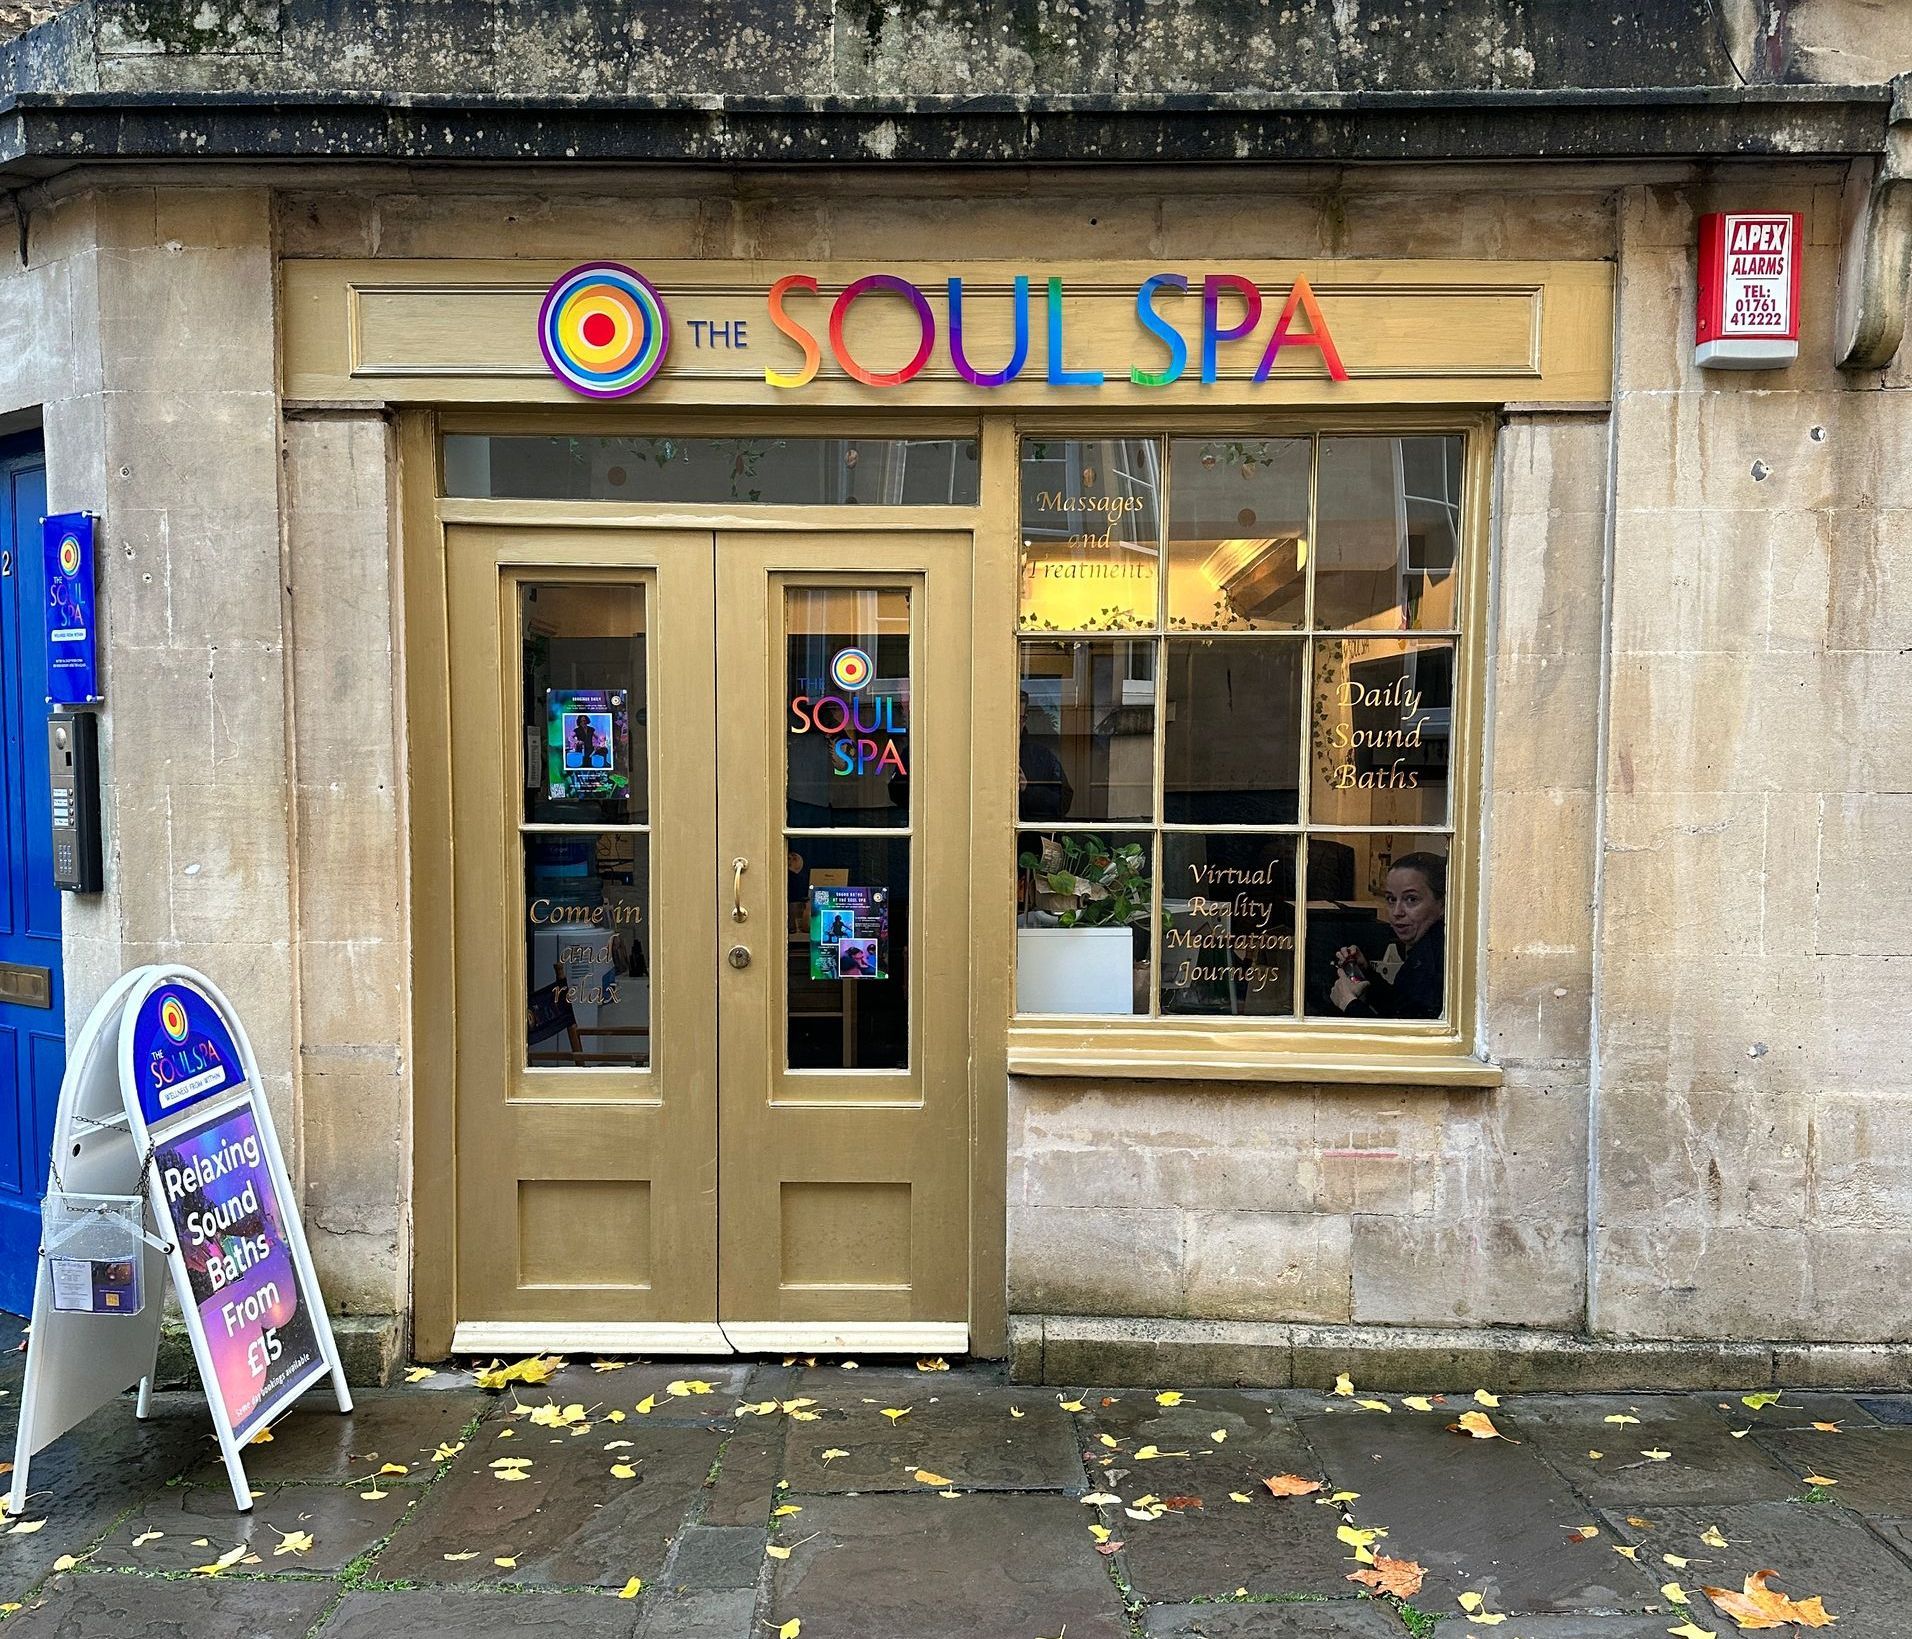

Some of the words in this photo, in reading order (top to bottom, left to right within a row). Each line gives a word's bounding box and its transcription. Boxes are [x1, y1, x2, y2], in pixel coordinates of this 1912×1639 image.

[1733, 224, 1785, 251] APEX
[1731, 257, 1784, 276] ALARMS
[1735, 299, 1776, 312] 01761
[1743, 285, 1771, 298] TEL:
[687, 320, 747, 348] THE
[765, 273, 1104, 388] SOUL
[1130, 271, 1349, 387] SPA
[1731, 313, 1782, 326] 412222
[1036, 491, 1144, 522] Massages
[1068, 522, 1118, 549] and
[2, 551, 11, 576] 2
[1026, 553, 1154, 579] Treatments
[50, 583, 86, 606] SOUL
[53, 576, 63, 584] THE
[61, 604, 85, 627] SPA
[1336, 674, 1423, 721] Daily
[791, 696, 907, 734] SOUL
[1332, 716, 1430, 749] Sound
[834, 738, 908, 776] SPA
[1333, 757, 1419, 789] Baths
[1188, 859, 1279, 885] Virtual
[529, 899, 604, 924] Come
[614, 899, 643, 924] in
[1187, 892, 1273, 928] Reality
[559, 933, 621, 964] and
[1166, 924, 1294, 949] Meditation
[551, 973, 622, 1004] relax
[1175, 961, 1279, 992] Journeys
[151, 1049, 164, 1060] THE
[151, 1050, 195, 1088] SOUL
[192, 1039, 221, 1070] SPA
[164, 1134, 261, 1202] Relaxing
[187, 1180, 258, 1246] Sound
[206, 1233, 270, 1292] Baths
[221, 1281, 280, 1338] From
[247, 1327, 283, 1378] £15
[260, 1372, 286, 1397] bookings
[285, 1353, 311, 1377] available
